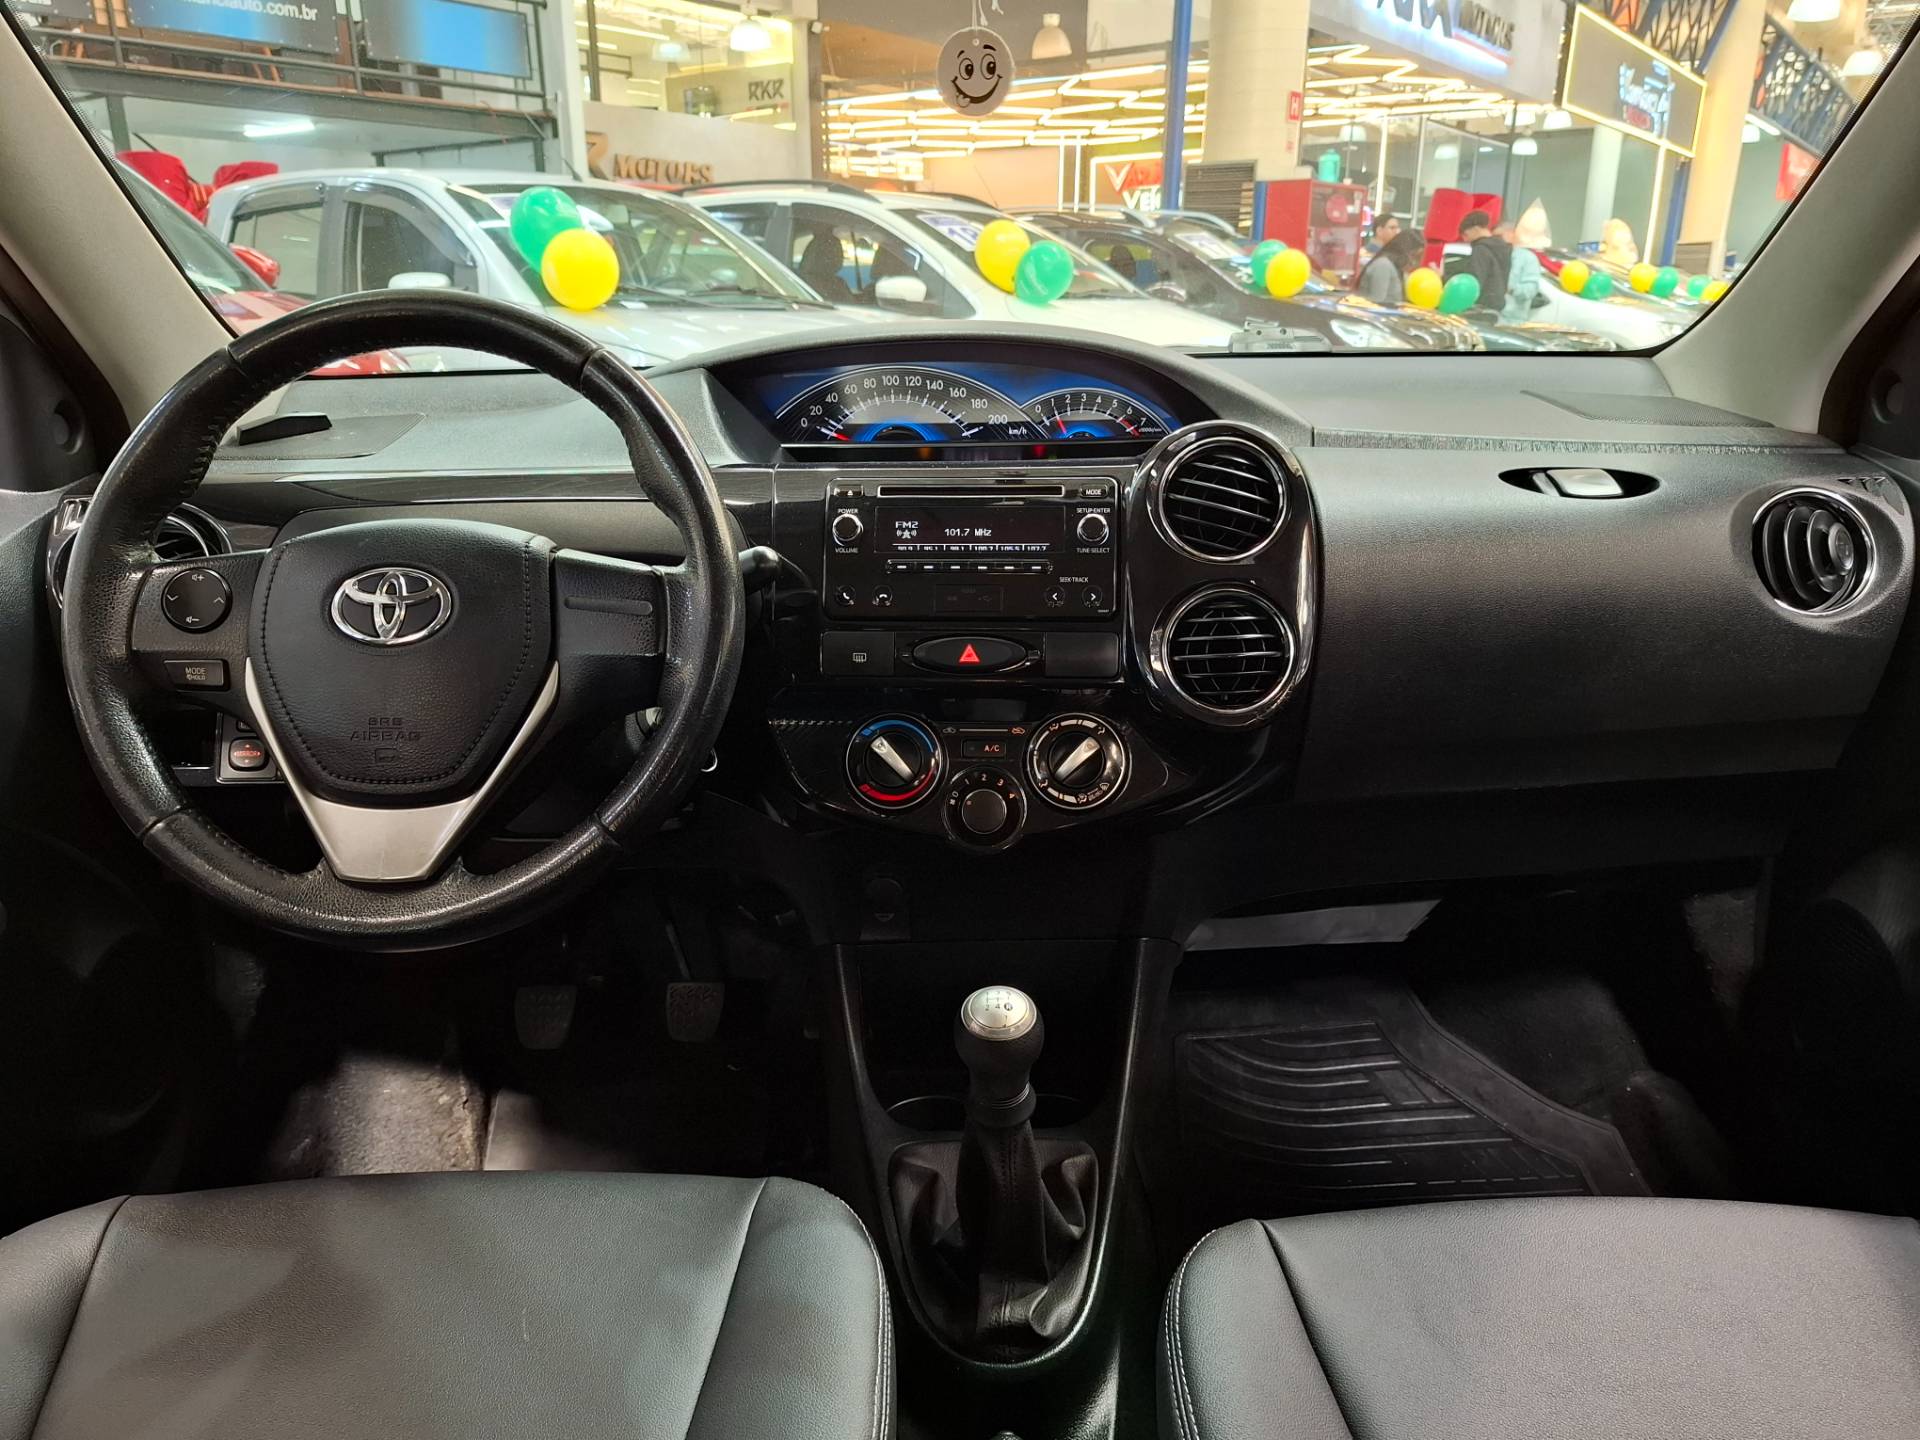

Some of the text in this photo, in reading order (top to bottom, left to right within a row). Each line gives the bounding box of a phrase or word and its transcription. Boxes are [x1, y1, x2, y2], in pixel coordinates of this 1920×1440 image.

[800, 375, 1008, 427] 0 20 40 60 80 100 120 140 160 180 200
[1035, 405, 1042, 413] 0
[1065, 394, 1071, 404] 2
[1081, 393, 1087, 402] 3
[1096, 396, 1102, 404] 4
[1112, 399, 1118, 408] 5
[1126, 406, 1133, 415] 6
[1140, 417, 1147, 426] 7
[1008, 426, 1027, 435] km/h
[895, 521, 918, 529] FM2
[944, 529, 992, 537] 101.7 MHz
[185, 667, 207, 675] MODE
[368, 716, 403, 727] SRS
[350, 730, 422, 741] AIRBAG
[981, 773, 987, 781] 2
